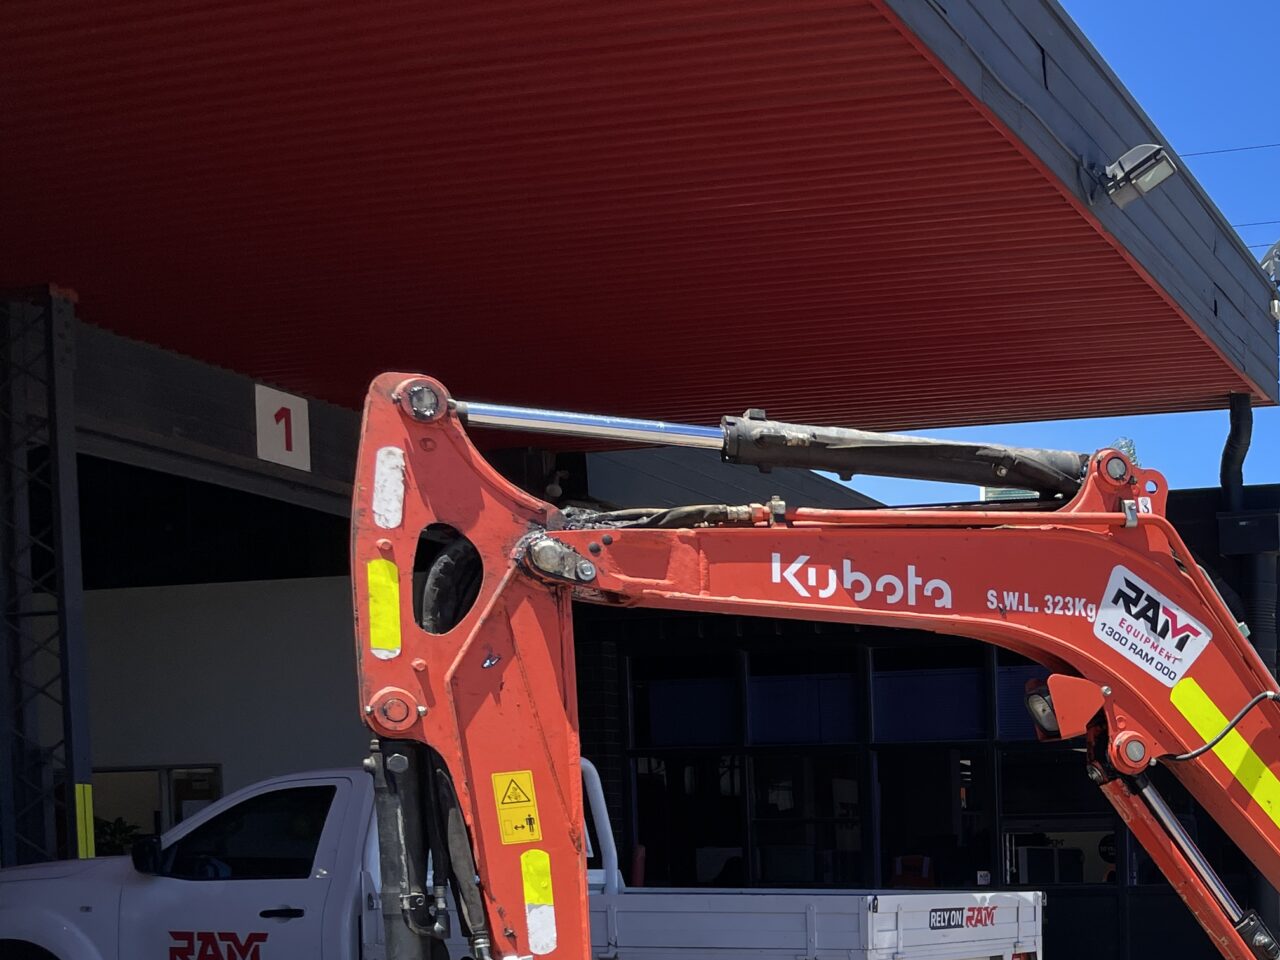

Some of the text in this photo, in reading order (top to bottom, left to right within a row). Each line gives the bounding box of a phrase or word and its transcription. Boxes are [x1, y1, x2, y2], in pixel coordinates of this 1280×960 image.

[273, 406, 294, 454] 1
[771, 552, 953, 609] Kubota
[986, 589, 1097, 623] S.W.L. 323Kg
[1111, 576, 1202, 653] RAM
[1100, 622, 1177, 681] 1300 RAM 000
[1118, 617, 1183, 665] EQUIPMENT
[930, 905, 998, 929] RELY ON RAM
